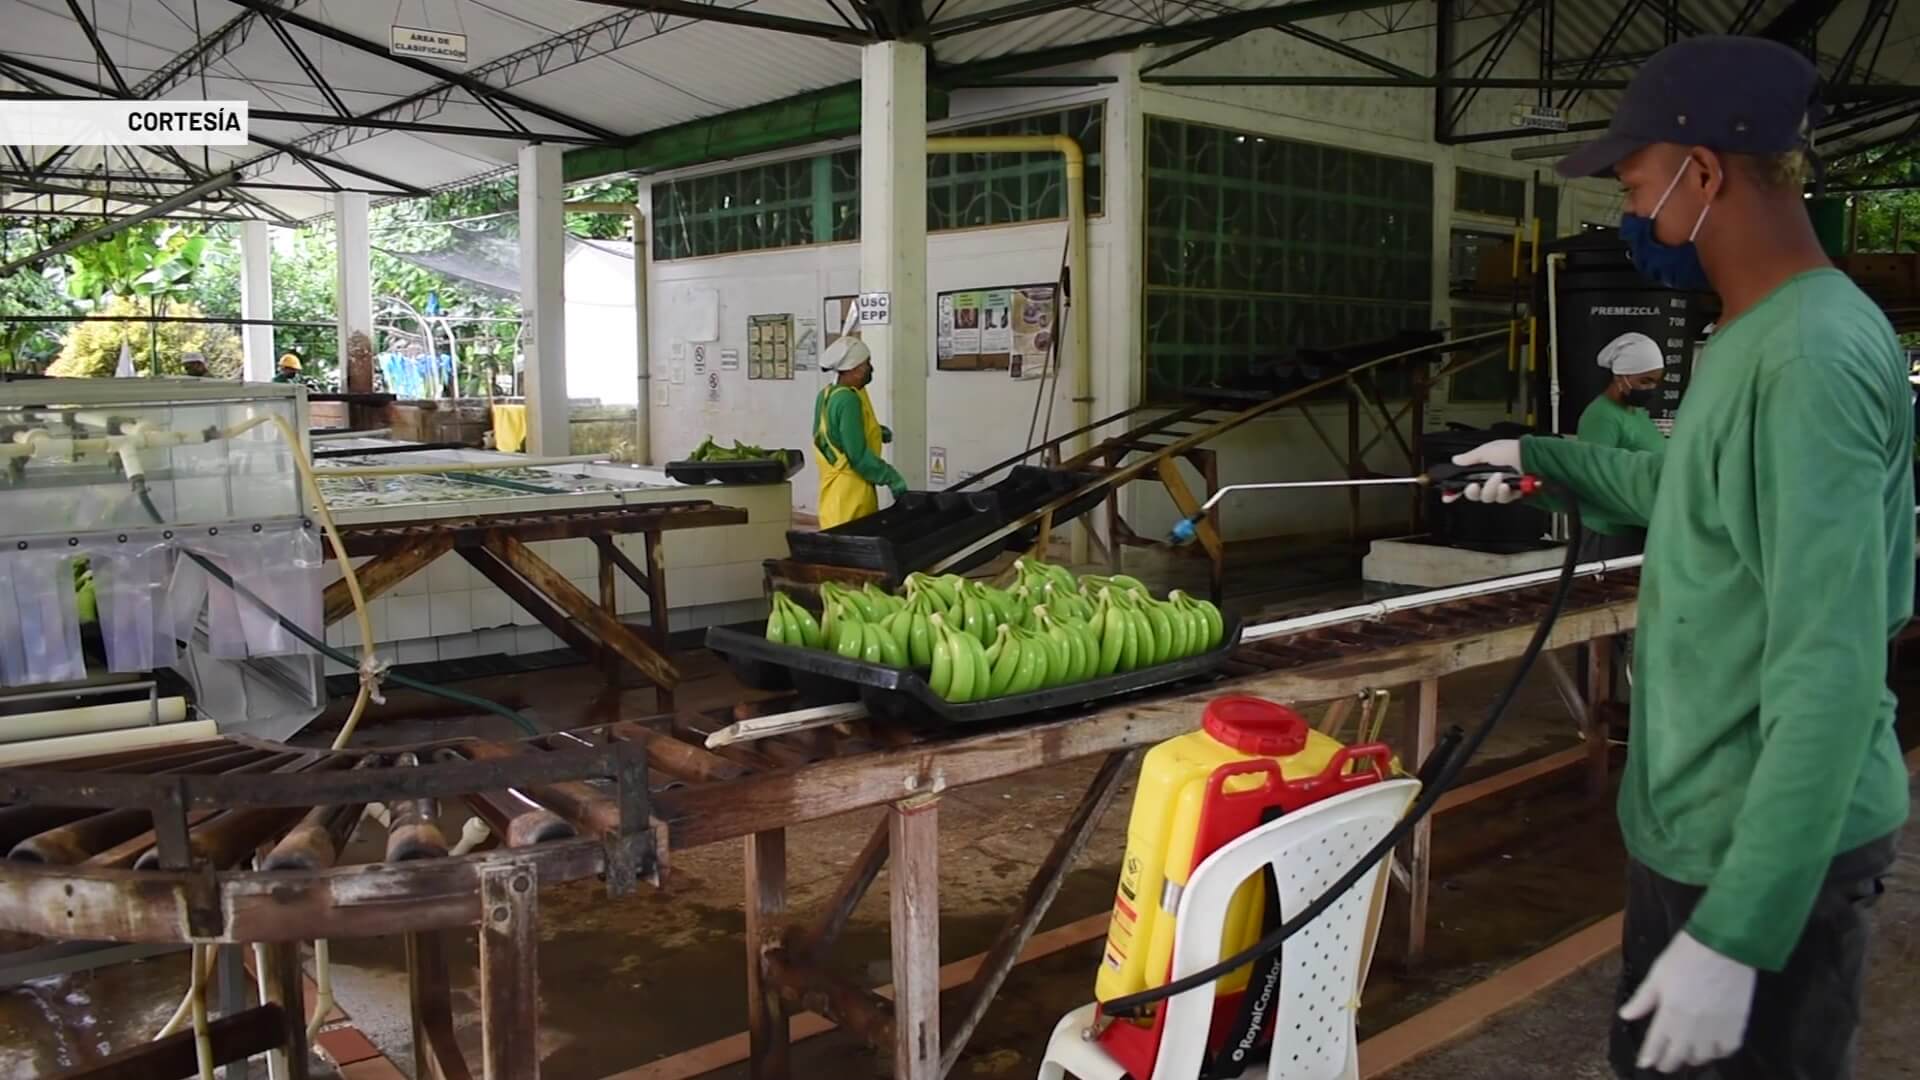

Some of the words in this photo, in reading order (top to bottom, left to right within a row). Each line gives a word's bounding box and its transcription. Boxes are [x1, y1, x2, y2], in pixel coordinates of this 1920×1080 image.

[861, 310, 887, 320] EPP
[1591, 306, 1660, 316] PREMEZCLA
[1669, 316, 1685, 327] 700
[1664, 372, 1681, 383] 400
[1661, 408, 1676, 418] 20
[1239, 958, 1281, 1049] RoyalCondor
